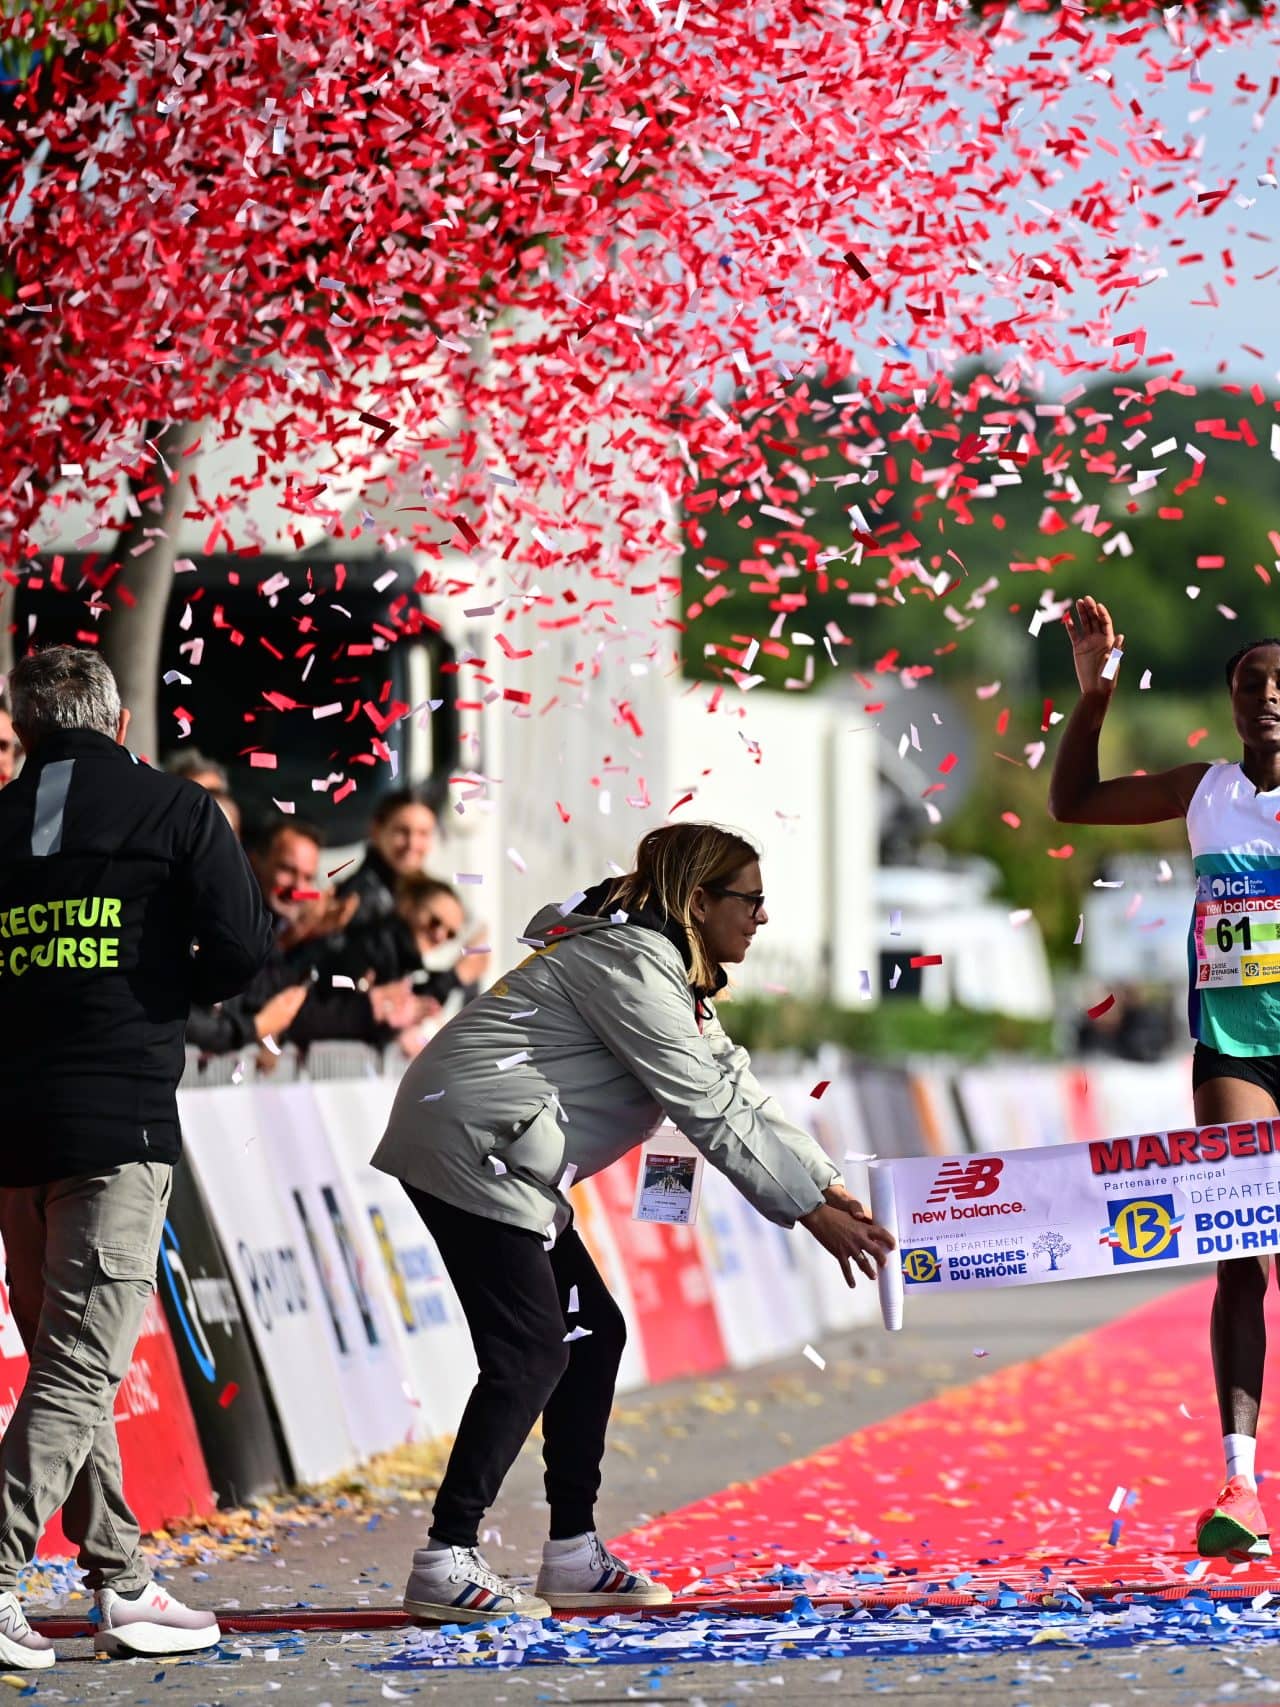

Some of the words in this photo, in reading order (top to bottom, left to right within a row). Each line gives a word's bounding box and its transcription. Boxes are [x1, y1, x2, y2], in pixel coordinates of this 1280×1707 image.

[1226, 876, 1250, 896] ici
[1206, 904, 1222, 914] new
[1216, 916, 1252, 953] 61
[1104, 1177, 1167, 1191] Partenaire
[1172, 1168, 1226, 1185] principal
[912, 1209, 947, 1225] new
[946, 1236, 1024, 1253] DÉPARTEMENT
